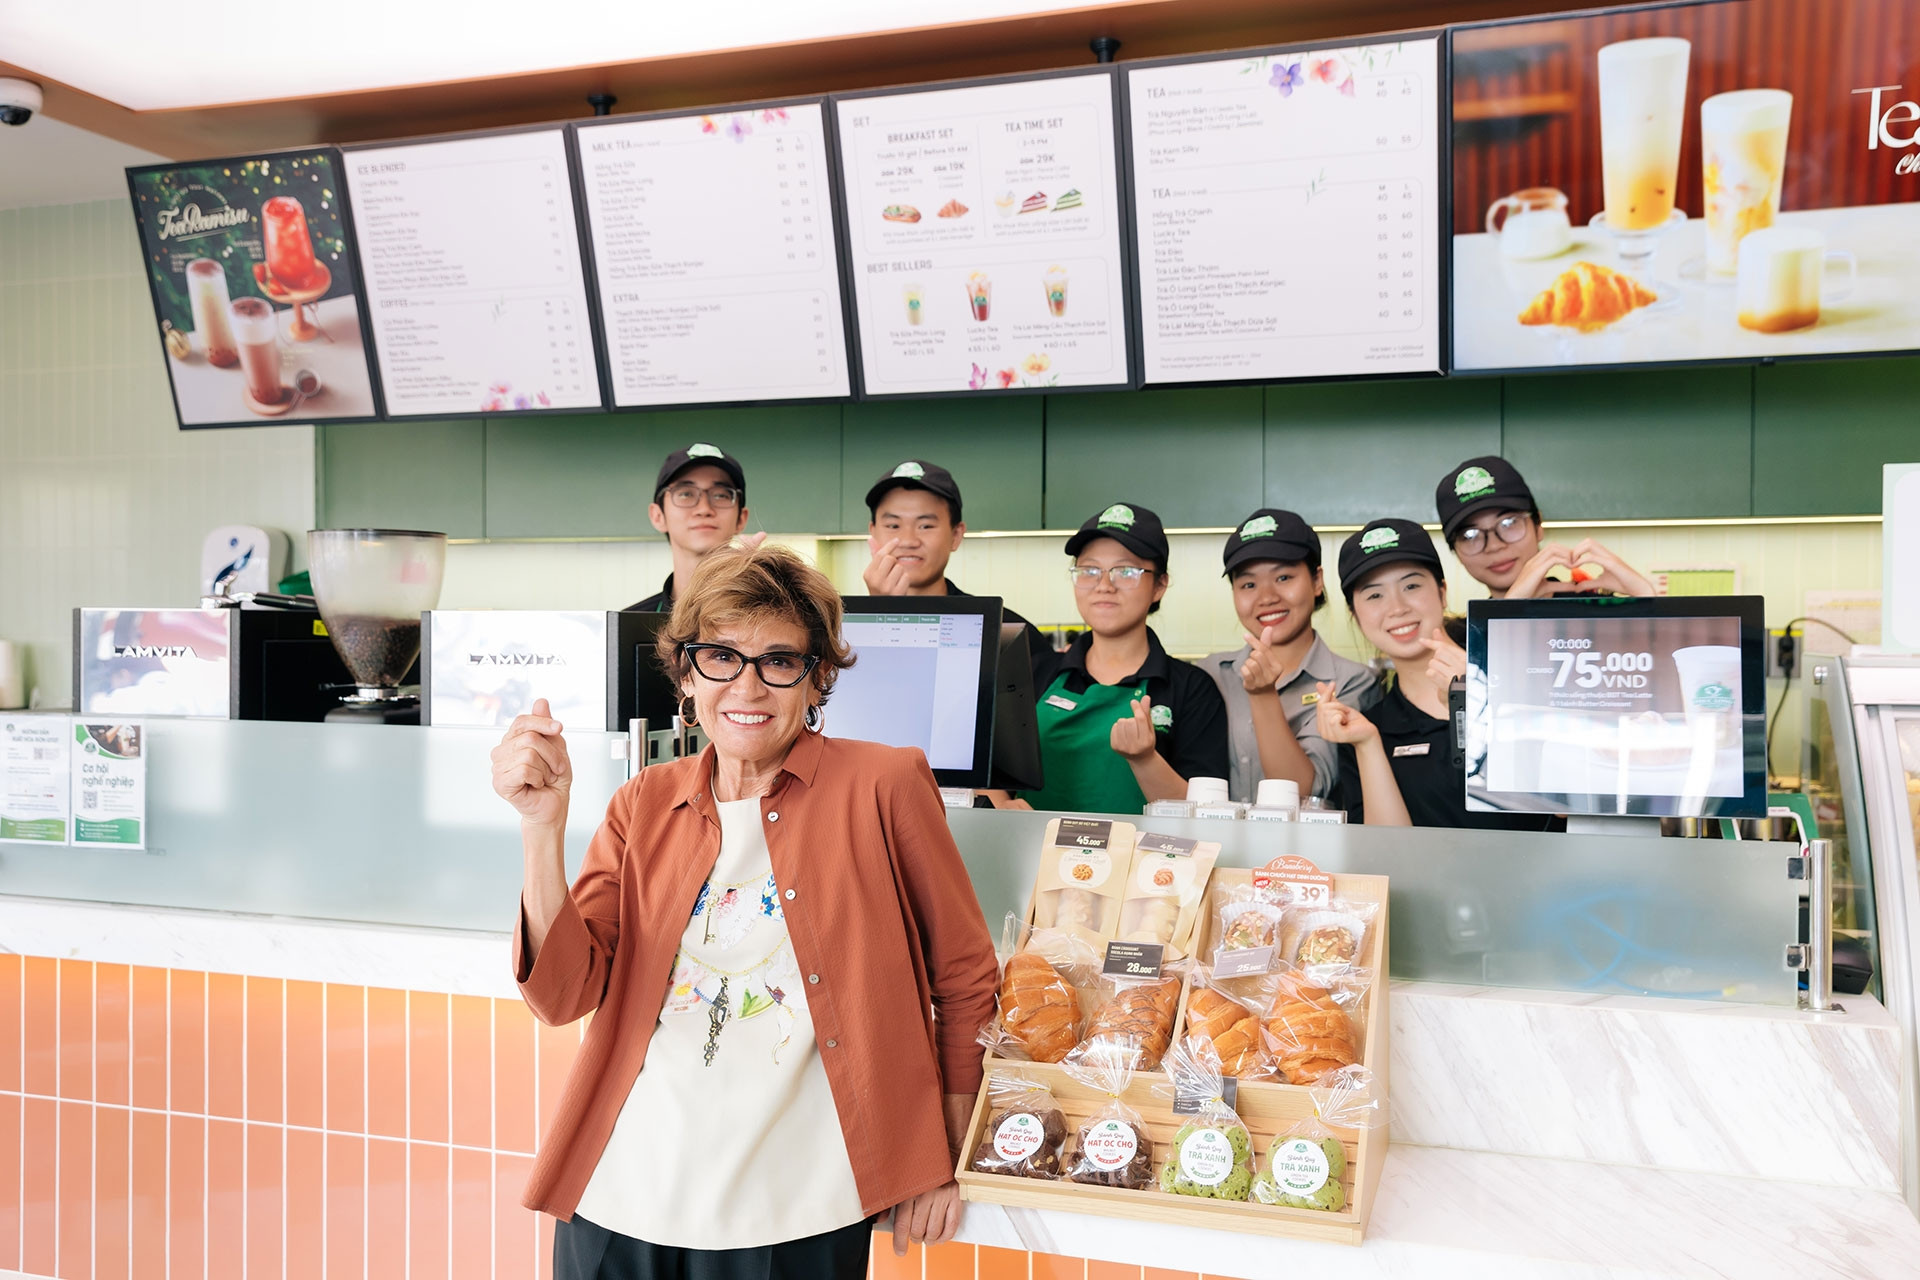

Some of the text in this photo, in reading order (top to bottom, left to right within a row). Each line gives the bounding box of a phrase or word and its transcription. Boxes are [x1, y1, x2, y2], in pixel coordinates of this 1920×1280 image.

[1147, 87, 1166, 99] TEA
[1005, 118, 1064, 133] TEA TIME SET
[887, 128, 953, 144] BREAKFAST SET
[1152, 188, 1171, 199] TEA
[867, 260, 932, 273] BEST SELLERS
[114, 645, 198, 659] LAMVITA
[468, 653, 567, 666] LAMVITA
[1549, 652, 1653, 688] 75.000
[1602, 674, 1647, 689] VND
[1204, 1153, 1227, 1164] XANH
[1297, 1163, 1320, 1173] XANH
